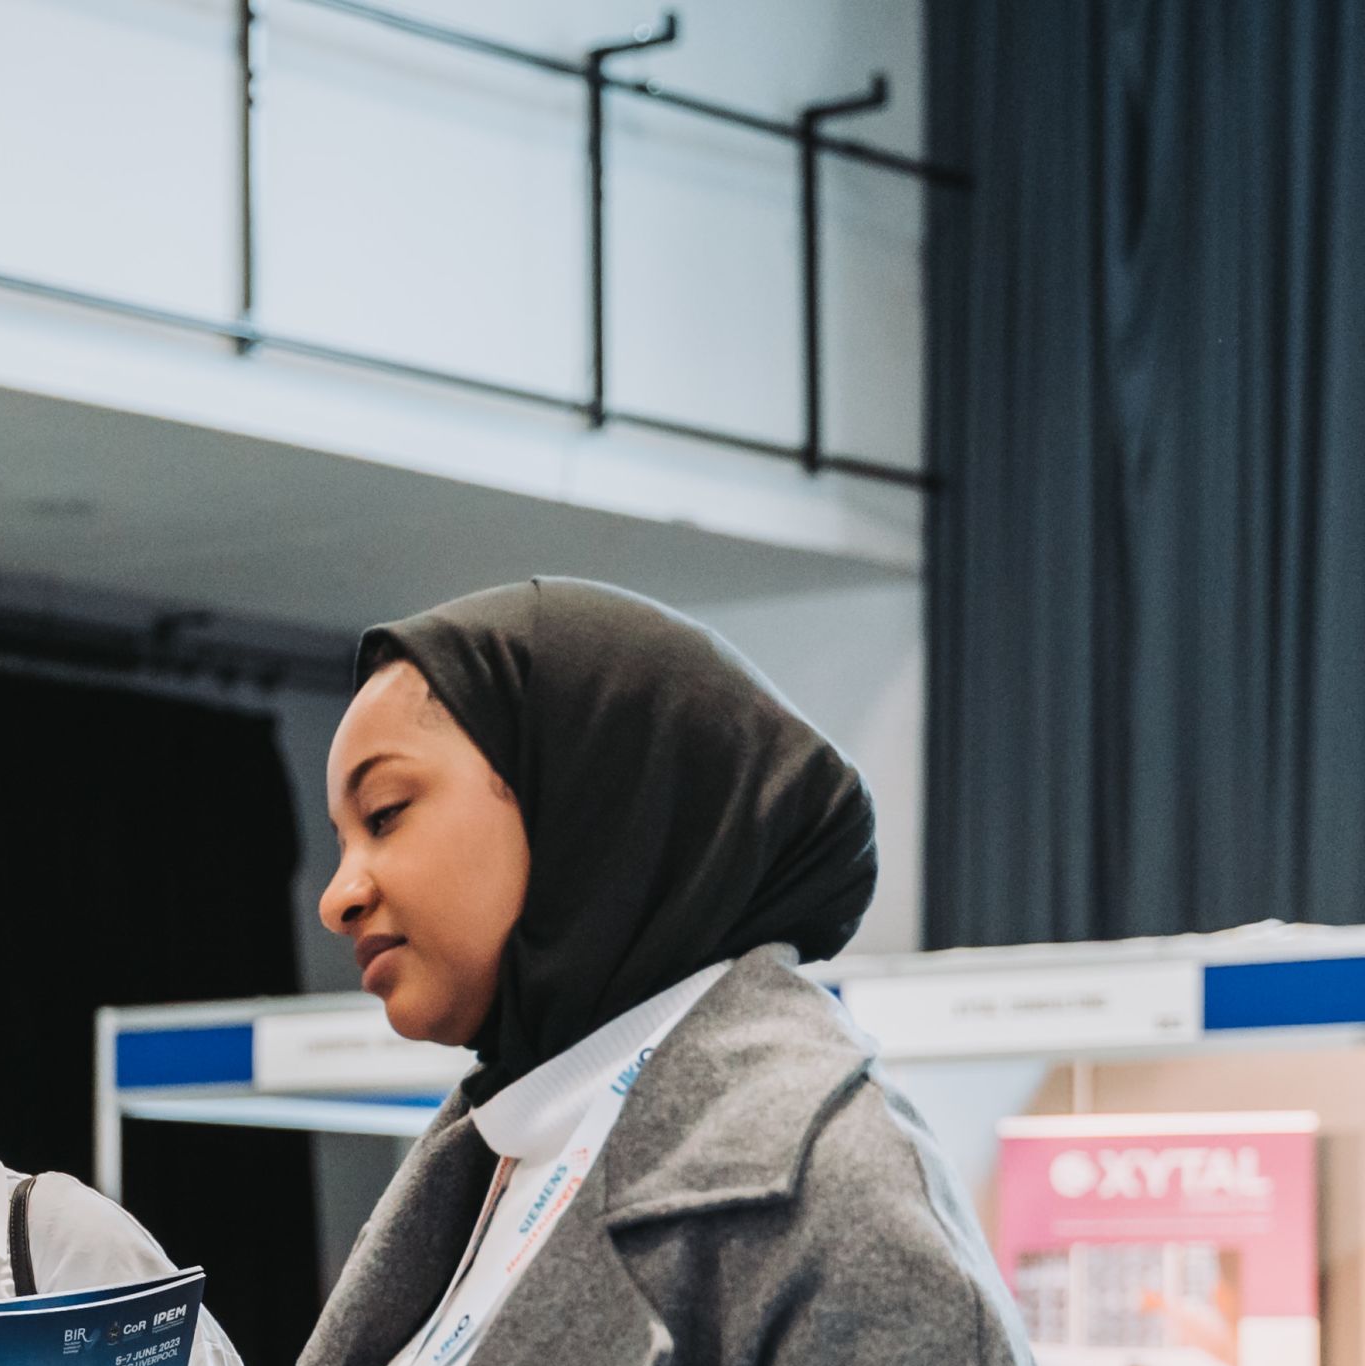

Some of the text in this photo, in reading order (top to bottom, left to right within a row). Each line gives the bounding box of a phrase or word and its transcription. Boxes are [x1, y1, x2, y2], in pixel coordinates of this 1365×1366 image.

[519, 1164, 567, 1235] SIEMENS
[123, 1320, 147, 1335] CoR
[153, 1304, 187, 1326] IPEM
[133, 1345, 157, 1361] JUNE
[158, 1337, 181, 1353] 2023
